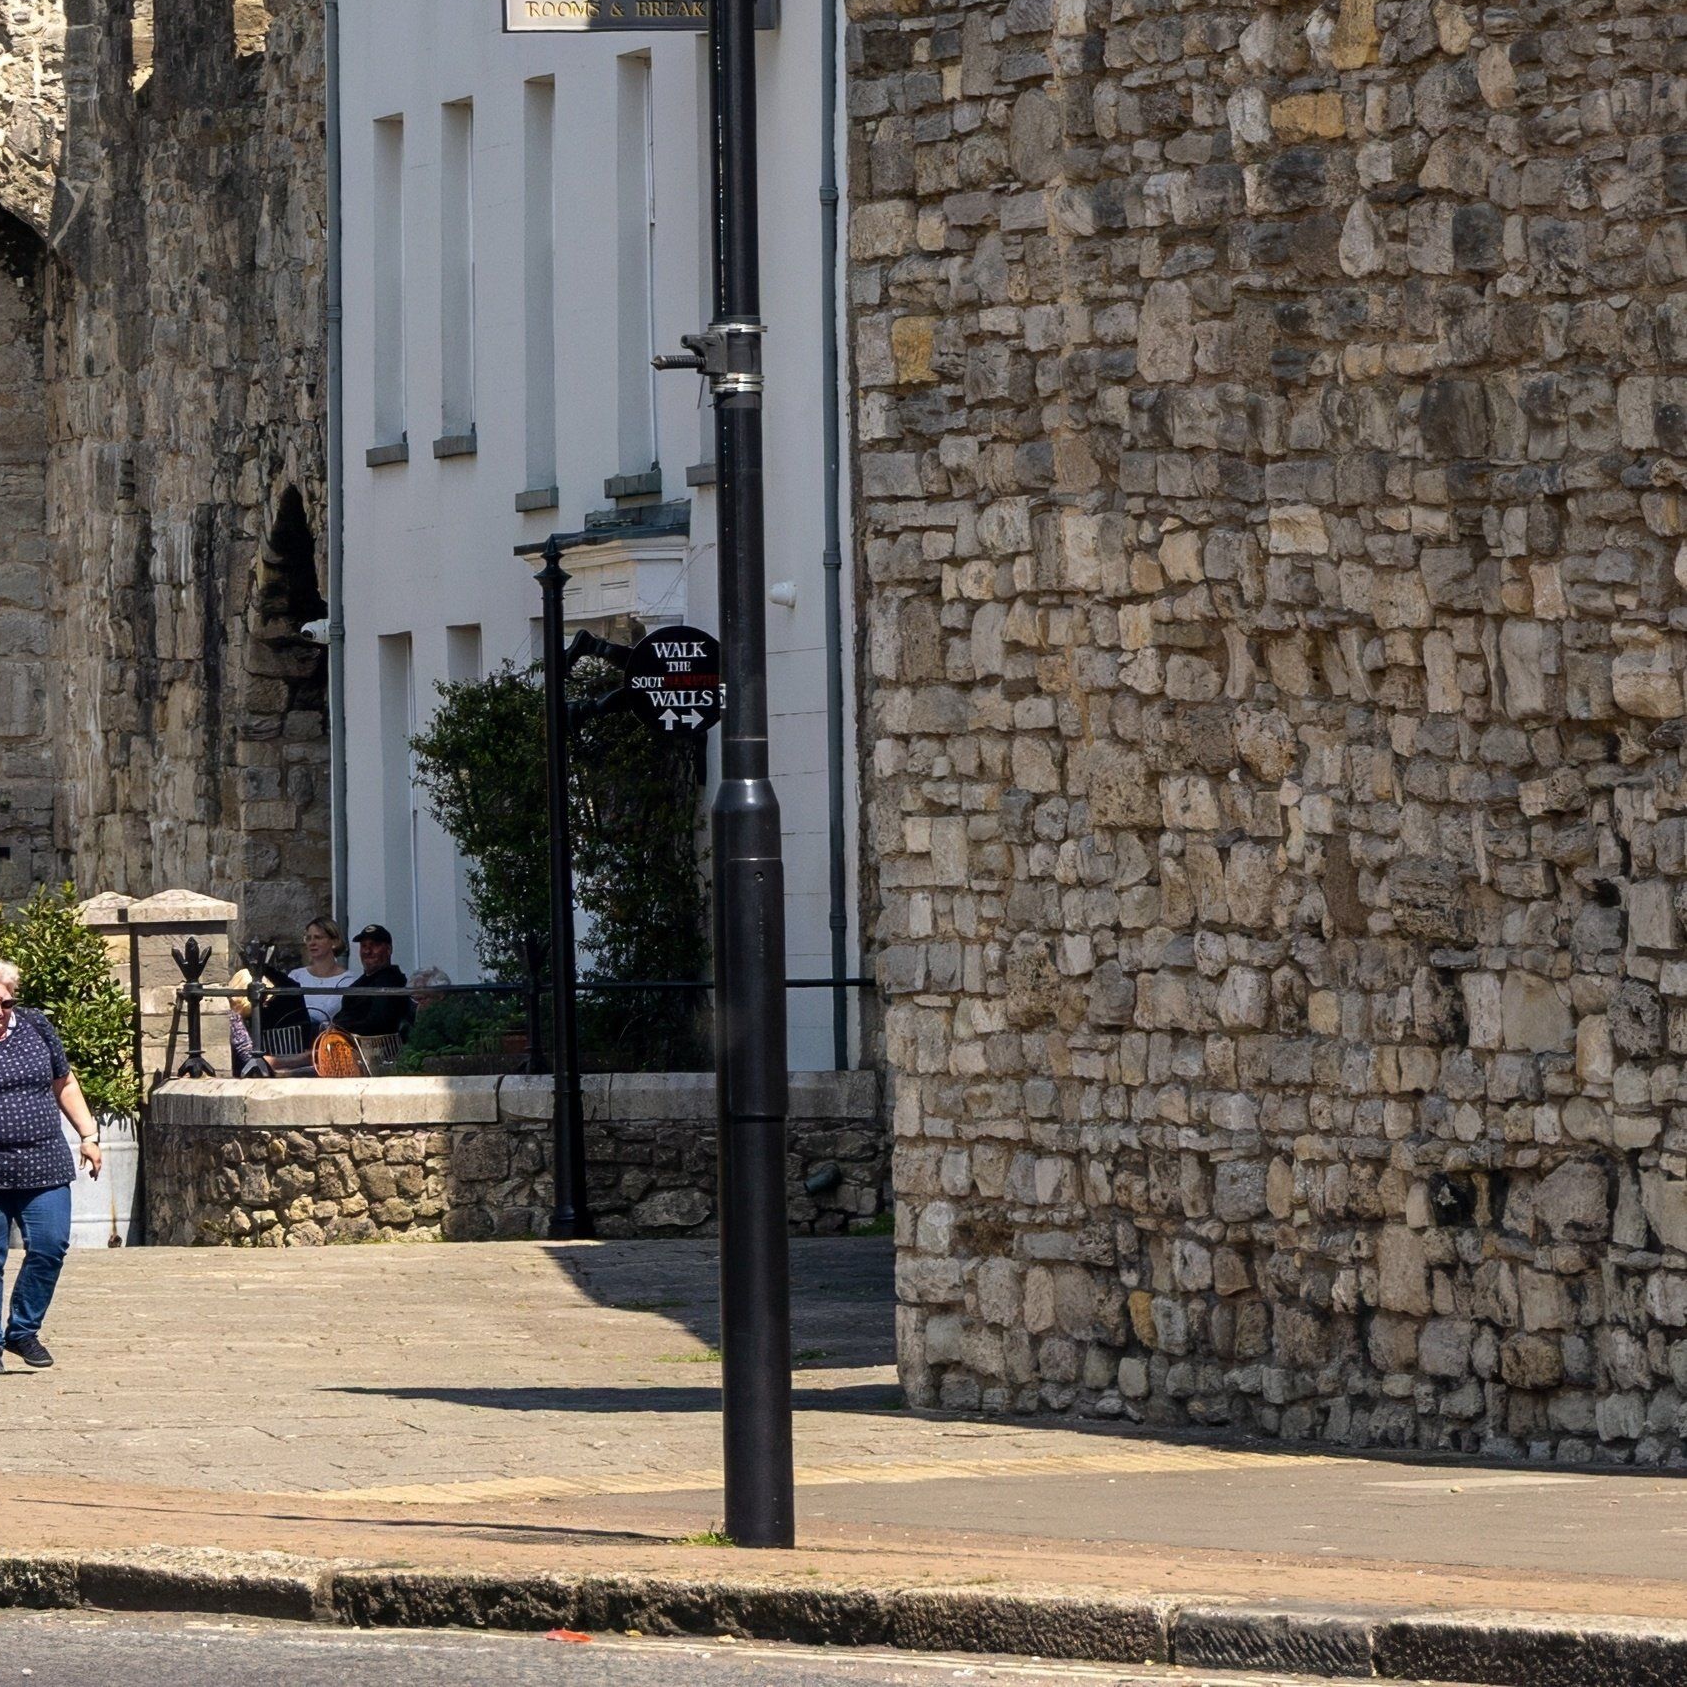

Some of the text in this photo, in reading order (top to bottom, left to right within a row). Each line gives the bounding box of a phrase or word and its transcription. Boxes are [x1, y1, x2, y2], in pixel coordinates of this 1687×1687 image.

[525, 0, 757, 18] ROOMS & BREAK
[651, 641, 707, 659] WALK
[666, 661, 692, 673] THE
[646, 690, 714, 707] WALLS
